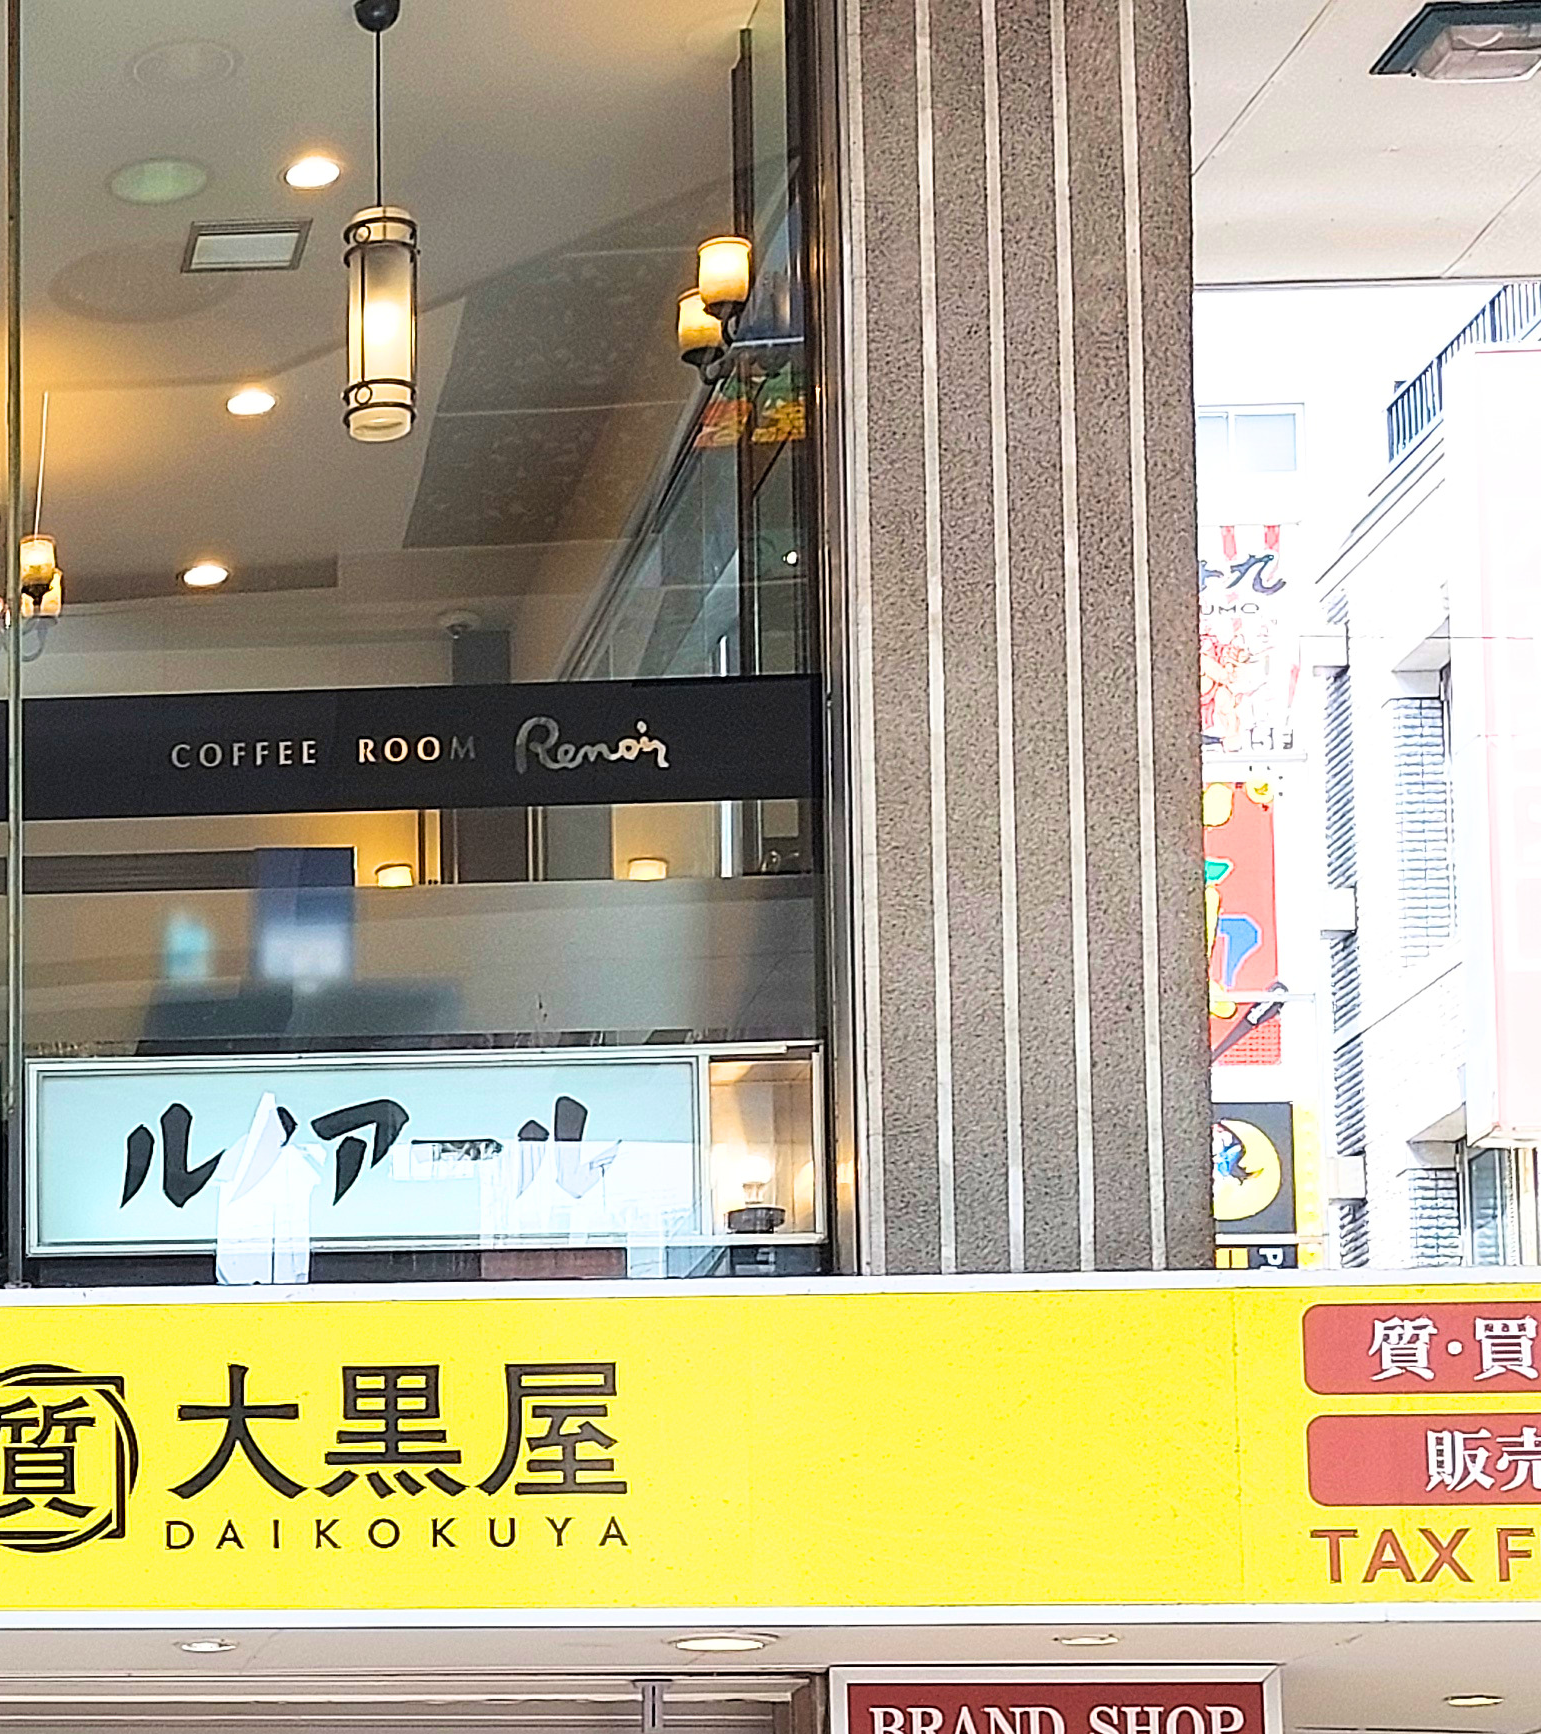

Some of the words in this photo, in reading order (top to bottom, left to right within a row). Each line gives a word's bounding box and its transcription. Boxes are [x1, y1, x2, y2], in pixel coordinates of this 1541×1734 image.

[170, 739, 319, 770] COFFEE
[358, 732, 477, 763] ROOM
[516, 717, 670, 775] Renoir
[168, 1363, 628, 1498] 大黒屋
[166, 1518, 628, 1549] DAIKOKUYA
[1310, 1527, 1474, 1583] TAX
